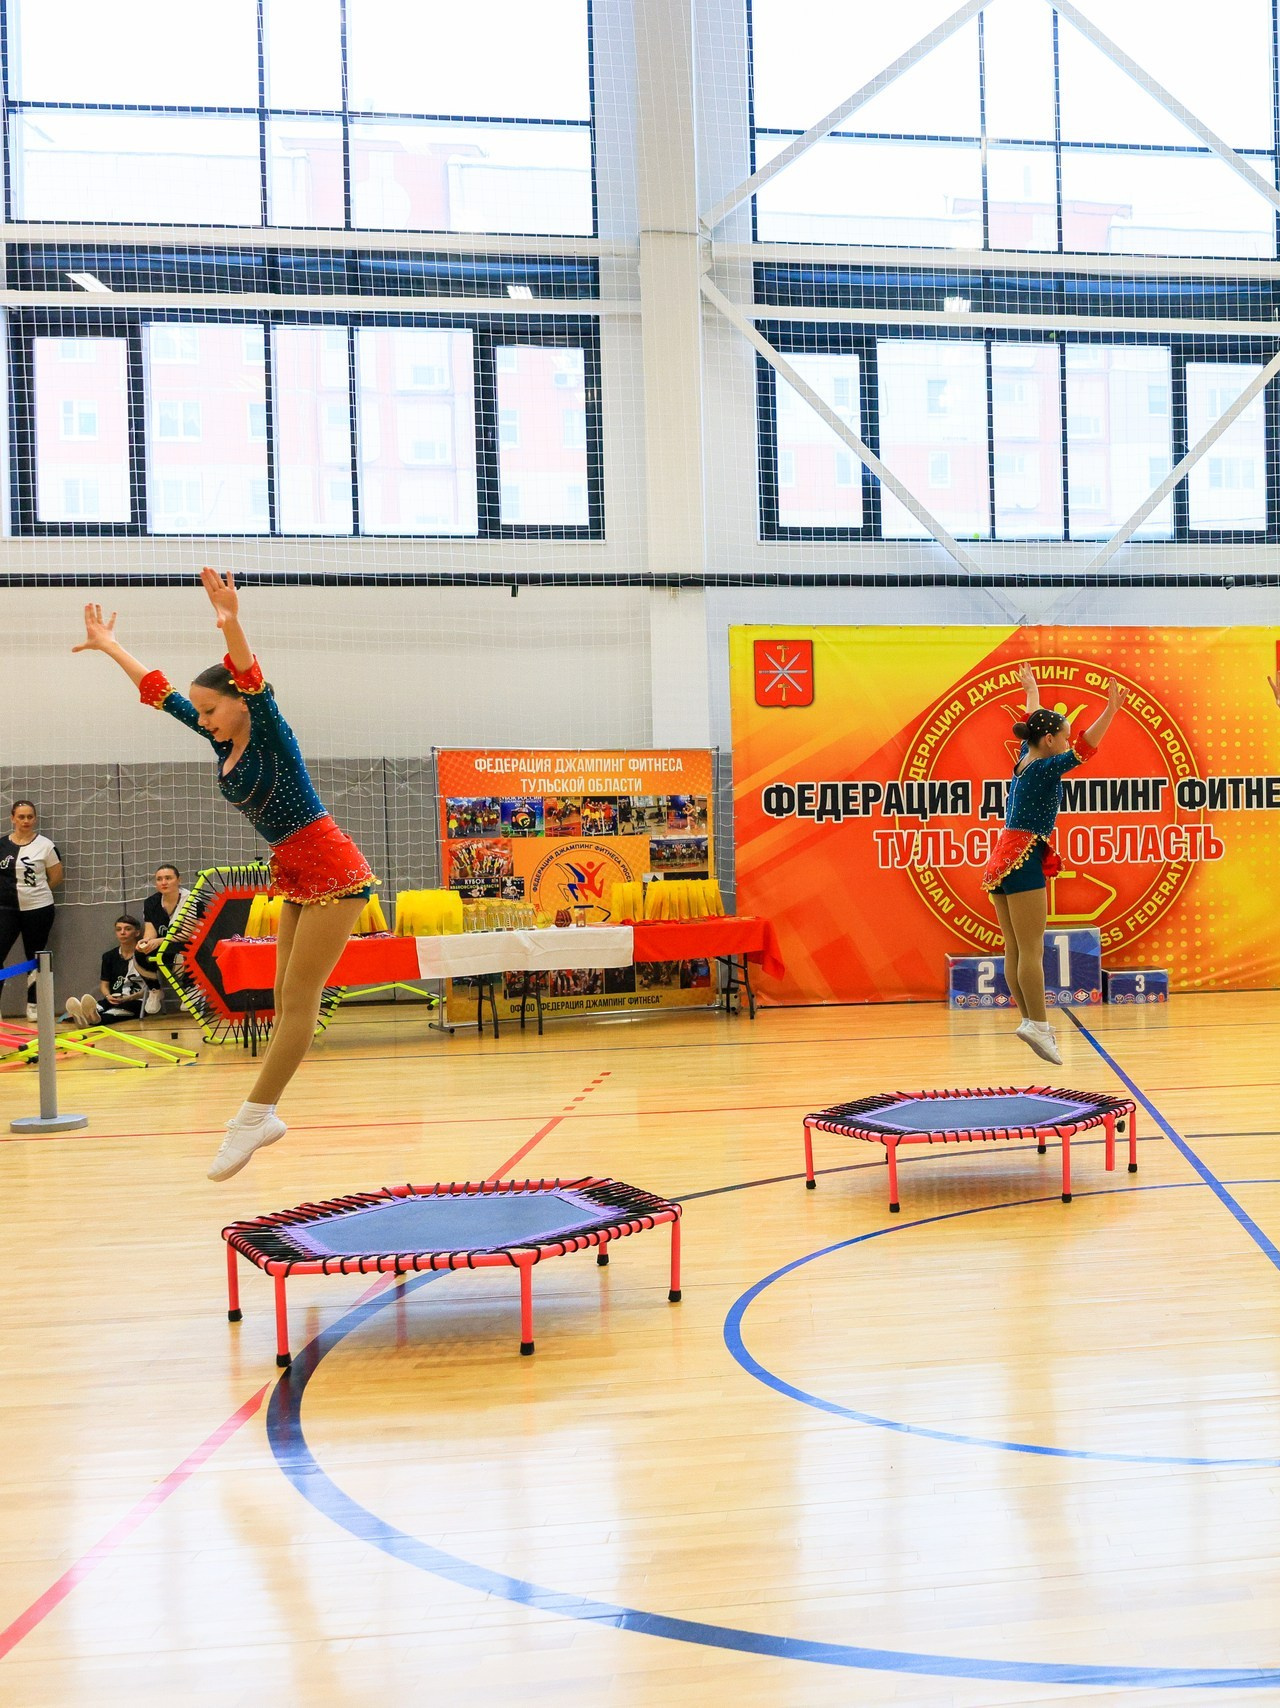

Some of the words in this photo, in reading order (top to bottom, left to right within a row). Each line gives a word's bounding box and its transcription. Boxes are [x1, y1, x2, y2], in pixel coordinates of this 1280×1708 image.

[909, 700, 965, 781] ДЕРАЦИЯ
[1160, 728, 1190, 780] РОСС
[474, 757, 552, 774] ФЕДЕРАЦИЯ
[554, 757, 626, 774] ДЖАМПИНГ
[628, 757, 684, 773] ФИТНЕСА
[520, 776, 585, 793] ТУЛЬСКОЙ
[587, 777, 643, 793] ОБЛАСТИ
[762, 780, 972, 823] ФЕДЕРАЦИЯ
[978, 776, 1169, 822] ДМПИНГ
[532, 855, 555, 893] ФЕДЕРАЦИЯ
[554, 843, 593, 858] ДЖАМПИНГ
[594, 845, 621, 865] ФИТНЕСА
[620, 864, 632, 882] РОСС
[873, 827, 1061, 870] ТУЛЬС
[1067, 823, 1226, 865] ОБЛАСТЬ
[915, 862, 956, 914] SIAN
[953, 914, 1006, 947] JUMP
[1125, 853, 1187, 932] FEDERAT
[977, 961, 995, 994] 2
[1053, 935, 1071, 988] 1
[1135, 974, 1146, 993] 3
[510, 1004, 535, 1014] ОФОО
[585, 997, 626, 1009] ДЖАМПИНГ
